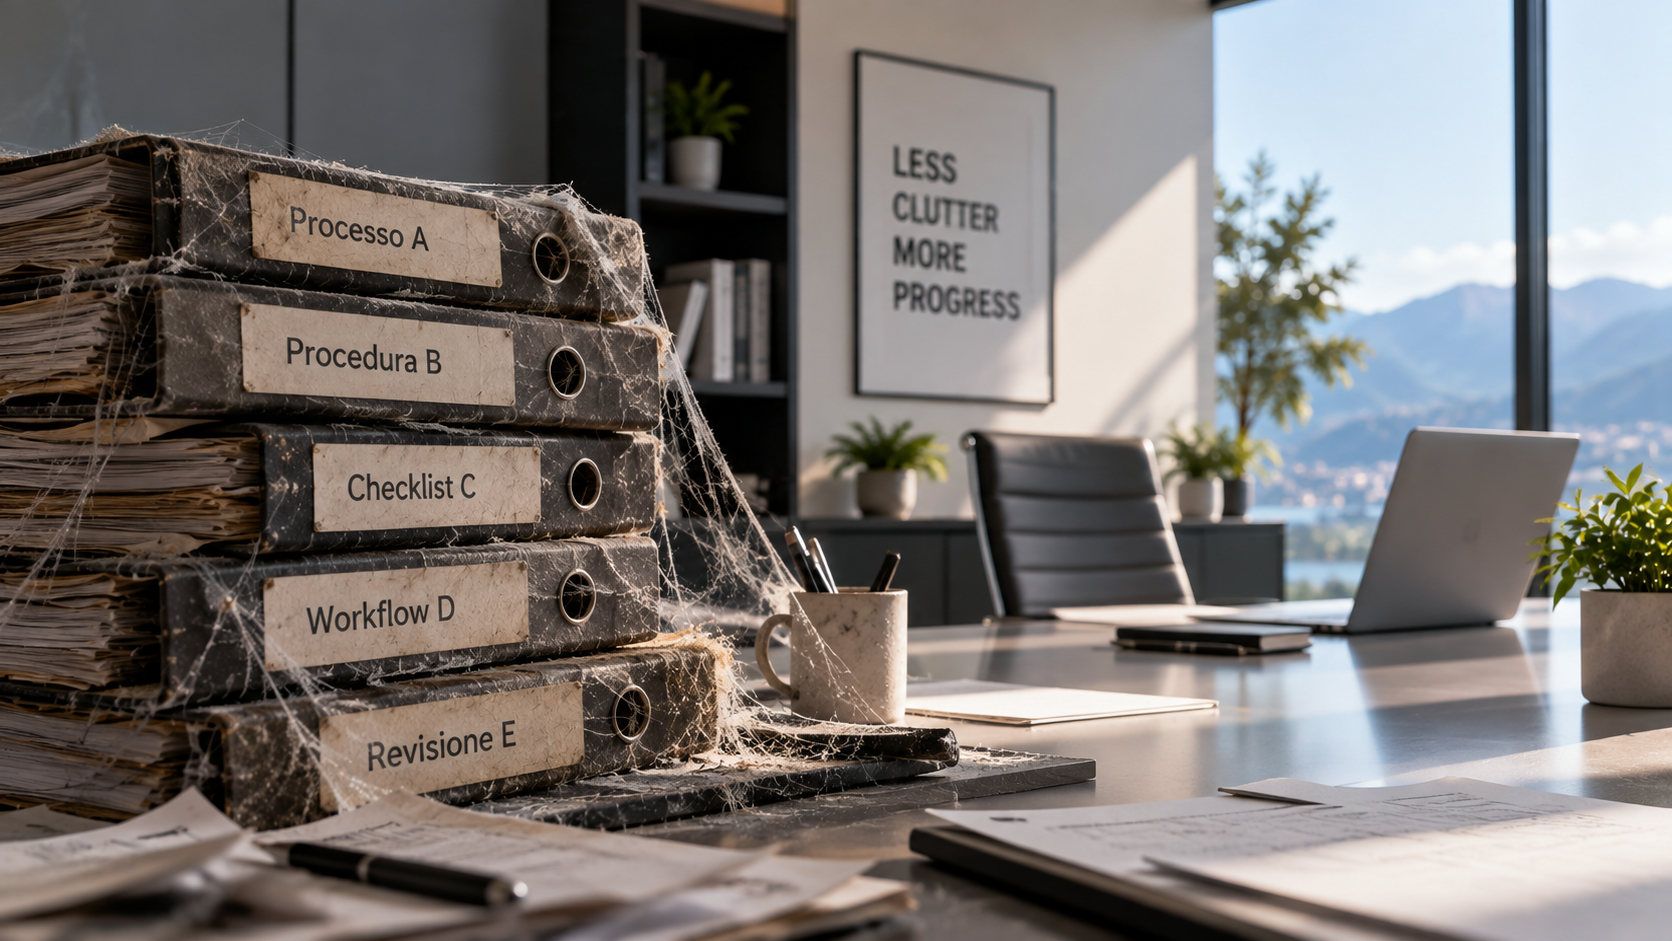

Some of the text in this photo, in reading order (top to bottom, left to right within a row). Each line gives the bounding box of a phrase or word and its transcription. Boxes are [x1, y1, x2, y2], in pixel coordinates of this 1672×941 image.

[894, 146, 956, 183] LESS
[289, 206, 429, 251] Processo A
[894, 191, 997, 231] CLUTTER
[894, 236, 965, 272] MORE
[894, 280, 1019, 320] PROGRESS
[287, 337, 441, 374] Procedura B
[348, 473, 476, 501] Checklist C
[306, 595, 454, 634] Workflow D
[367, 720, 516, 771] Revisione E
